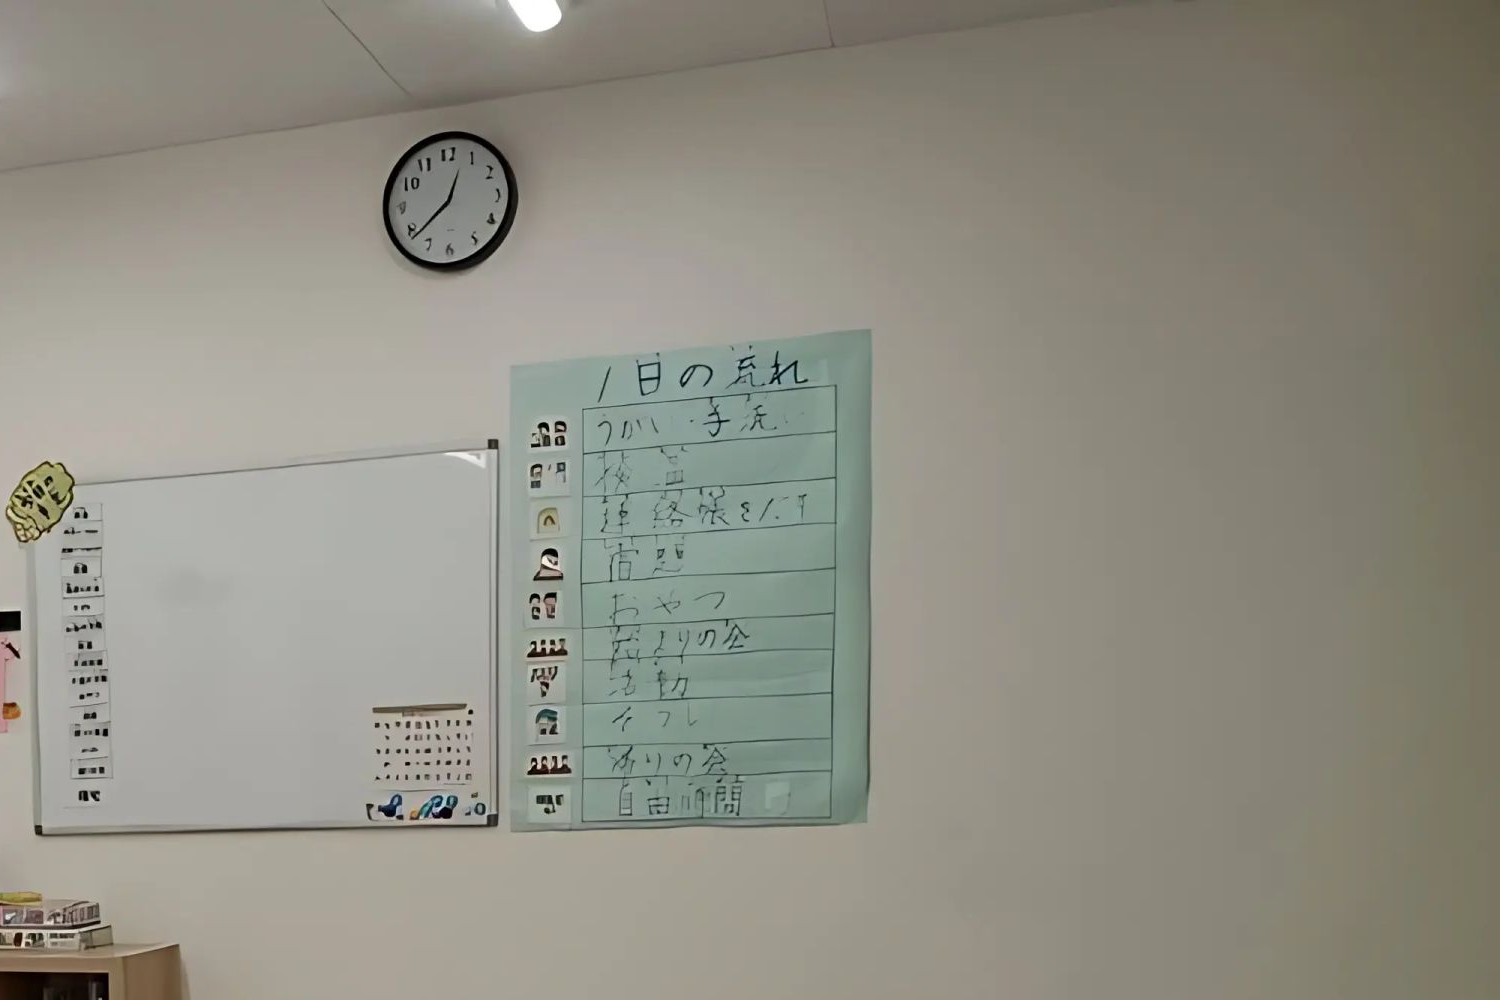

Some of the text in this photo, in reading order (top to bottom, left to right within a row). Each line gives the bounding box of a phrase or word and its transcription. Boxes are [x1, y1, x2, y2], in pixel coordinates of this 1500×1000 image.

[441, 147, 456, 162] 12
[469, 151, 475, 165] 1
[418, 157, 431, 172] 11
[485, 165, 494, 180] 2
[404, 177, 420, 191] 10
[424, 238, 432, 251] 7
[445, 243, 454, 255] 6
